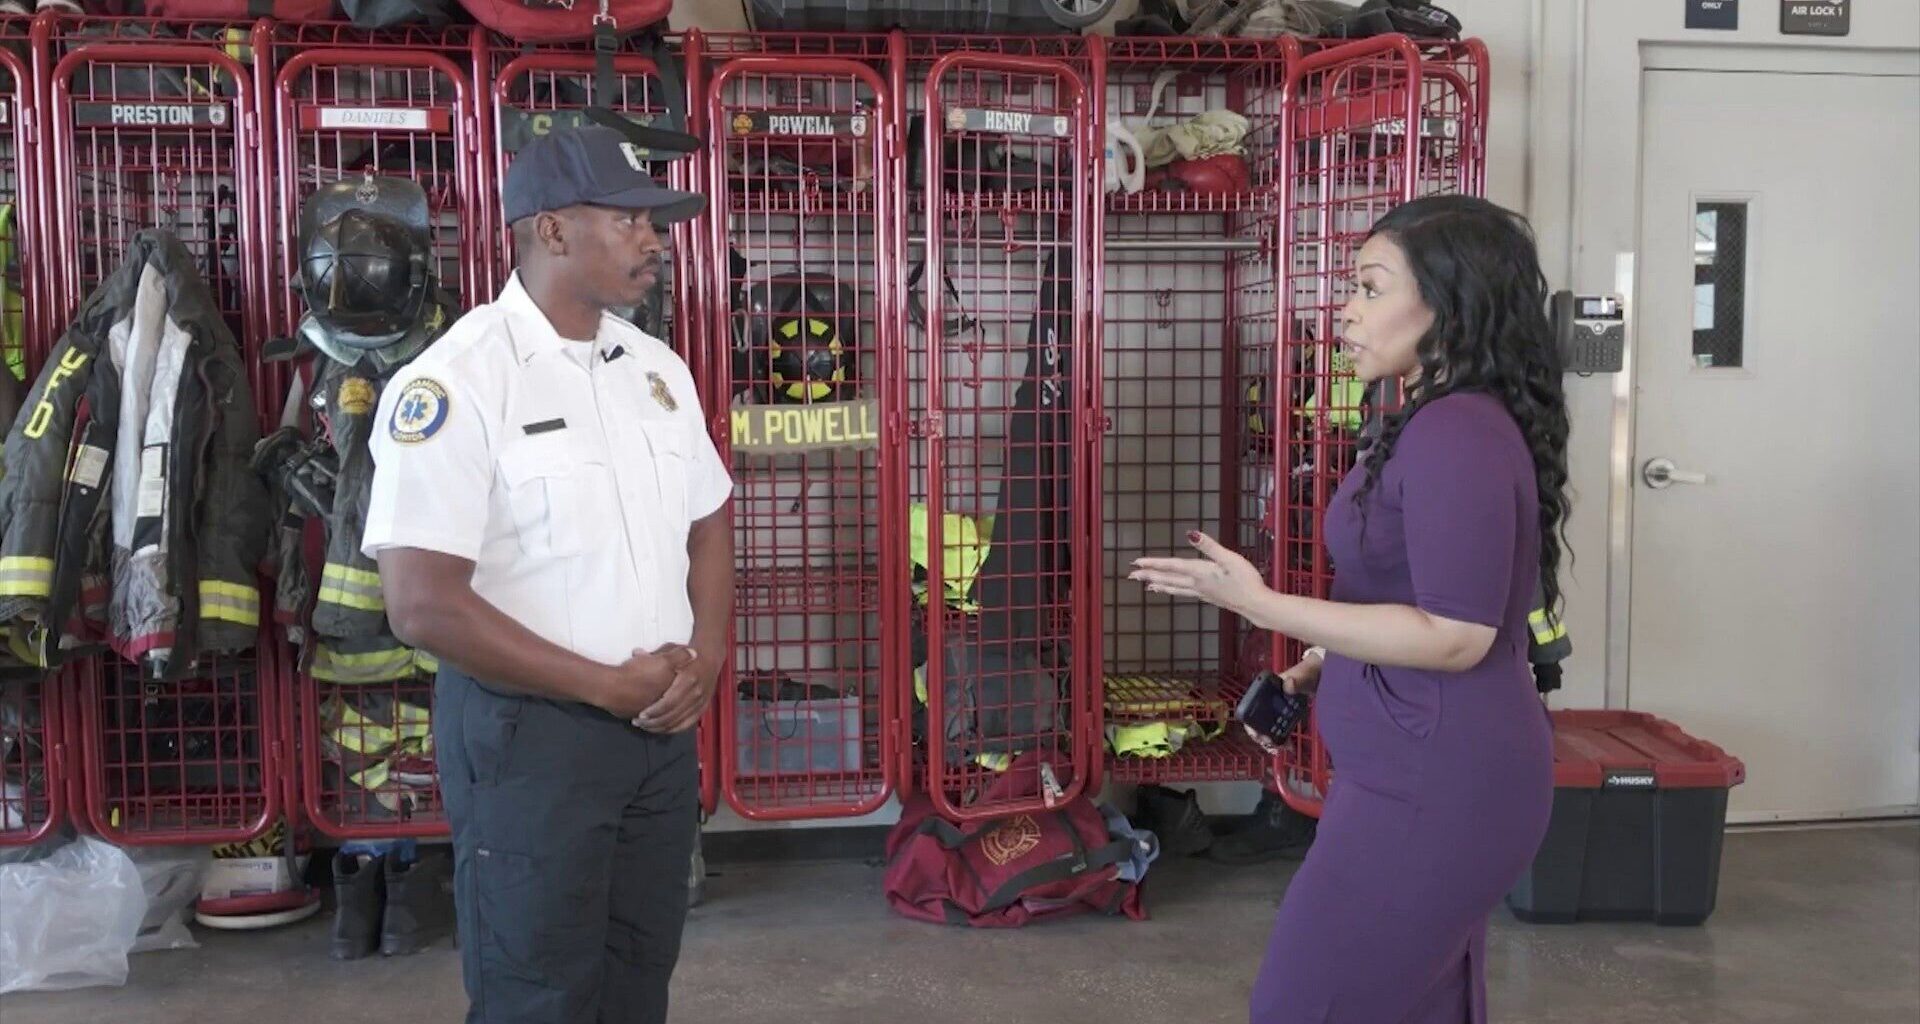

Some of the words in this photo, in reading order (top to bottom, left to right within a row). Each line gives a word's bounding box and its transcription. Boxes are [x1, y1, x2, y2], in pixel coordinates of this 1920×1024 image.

[1791, 6, 1808, 15] AIR
[1810, 6, 1835, 16] LOCK
[1837, 7, 1843, 16] 1
[111, 104, 194, 125] PRESTON
[342, 110, 407, 125] DANIELS
[985, 110, 1032, 133] HENRY
[768, 115, 834, 135] POWELL
[731, 410, 759, 446] M.
[764, 405, 878, 446] POWELL
[1619, 776, 1654, 785] HUSKY
